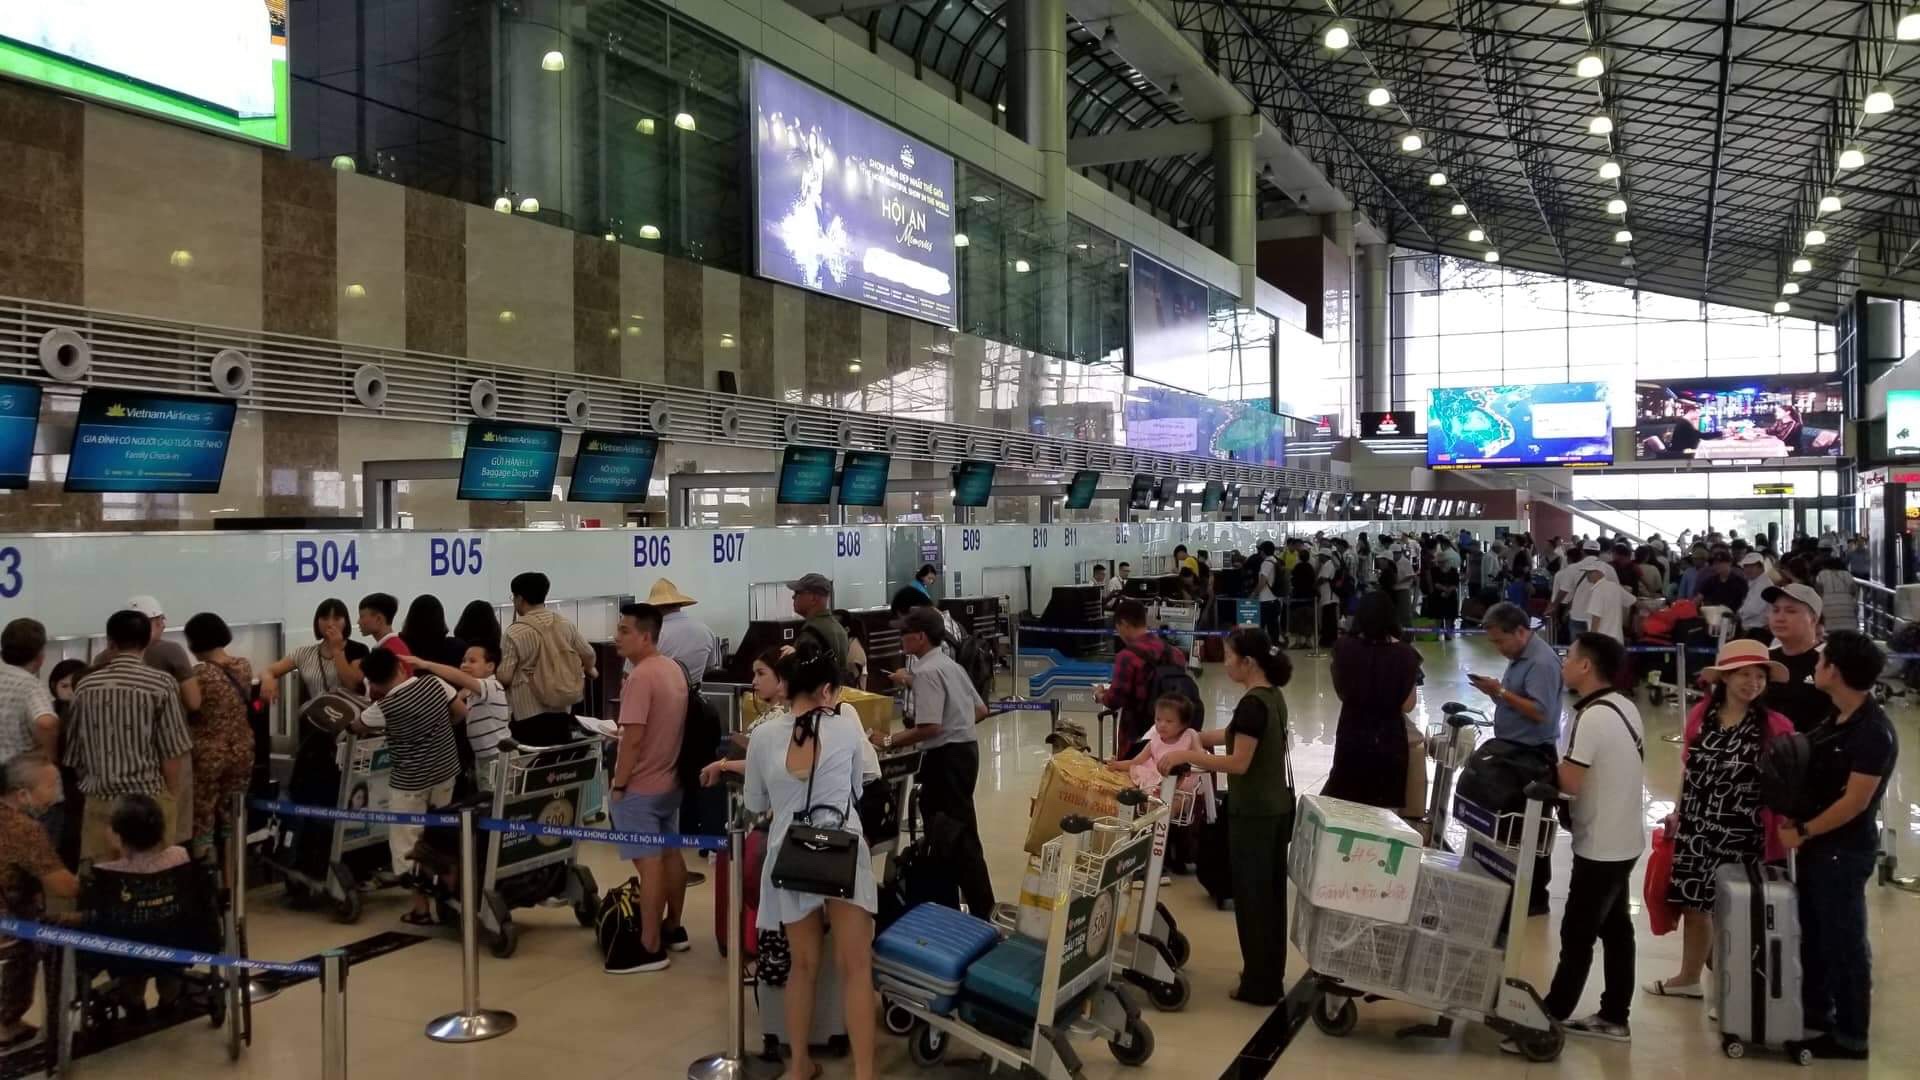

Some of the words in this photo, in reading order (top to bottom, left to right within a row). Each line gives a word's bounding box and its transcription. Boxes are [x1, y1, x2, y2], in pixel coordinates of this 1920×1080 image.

[882, 196, 905, 227] HỘI
[909, 208, 926, 233] AN
[896, 223, 934, 253] Memories
[125, 451, 149, 461] Family
[481, 467, 512, 479] Baggage
[633, 535, 671, 567] B06
[713, 532, 745, 563] B07
[837, 531, 861, 557] B08
[962, 528, 981, 551] B09
[1033, 527, 1048, 548] B10
[1064, 527, 1077, 546] B11
[296, 540, 359, 583] B04
[430, 538, 482, 576] B05
[1153, 823, 1167, 857] 2118
